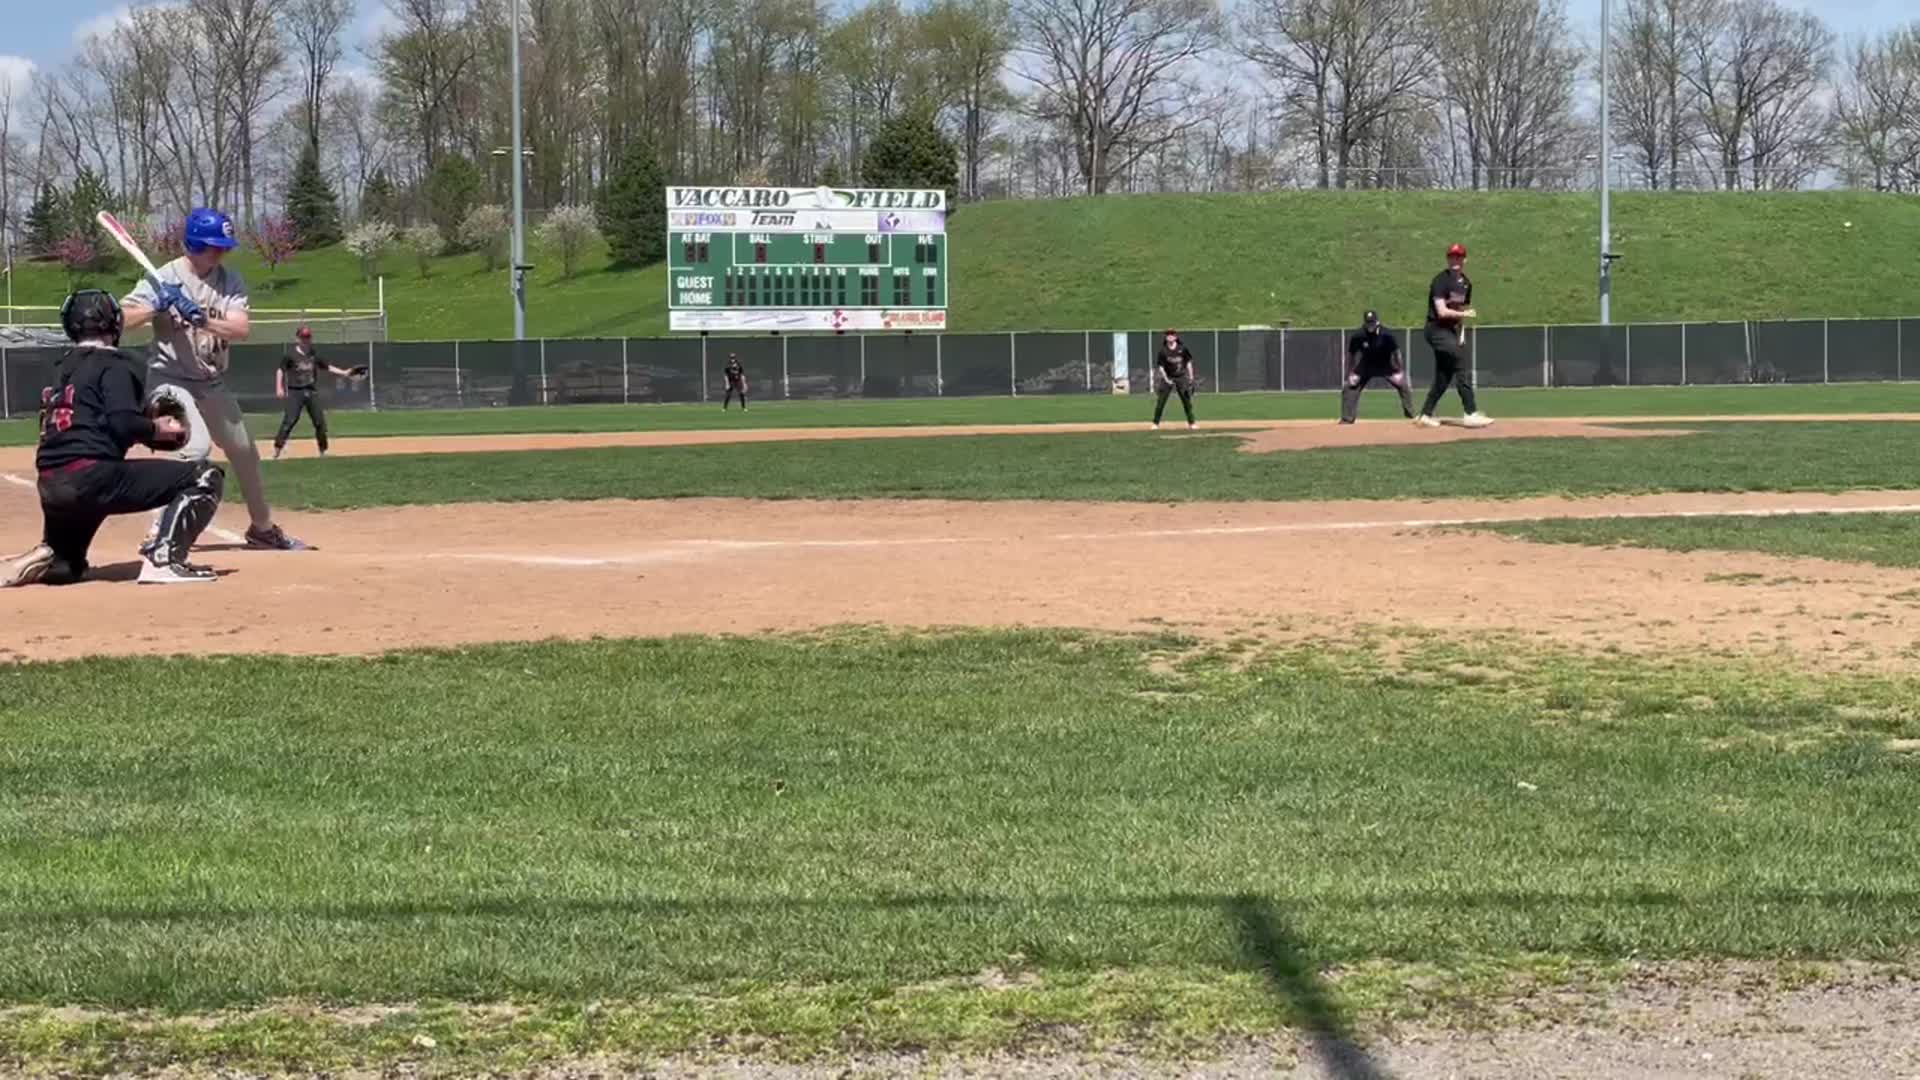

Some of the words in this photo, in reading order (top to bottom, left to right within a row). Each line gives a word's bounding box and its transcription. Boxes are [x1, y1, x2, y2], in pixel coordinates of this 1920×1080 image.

[673, 189, 790, 207] VACCARO
[852, 191, 940, 208] FIELD
[698, 213, 722, 225] FOX
[749, 233, 772, 244] BALL
[803, 234, 834, 244] STRIKE
[864, 234, 882, 244] OUT
[676, 276, 715, 289] GUEST
[679, 292, 713, 305] HOME
